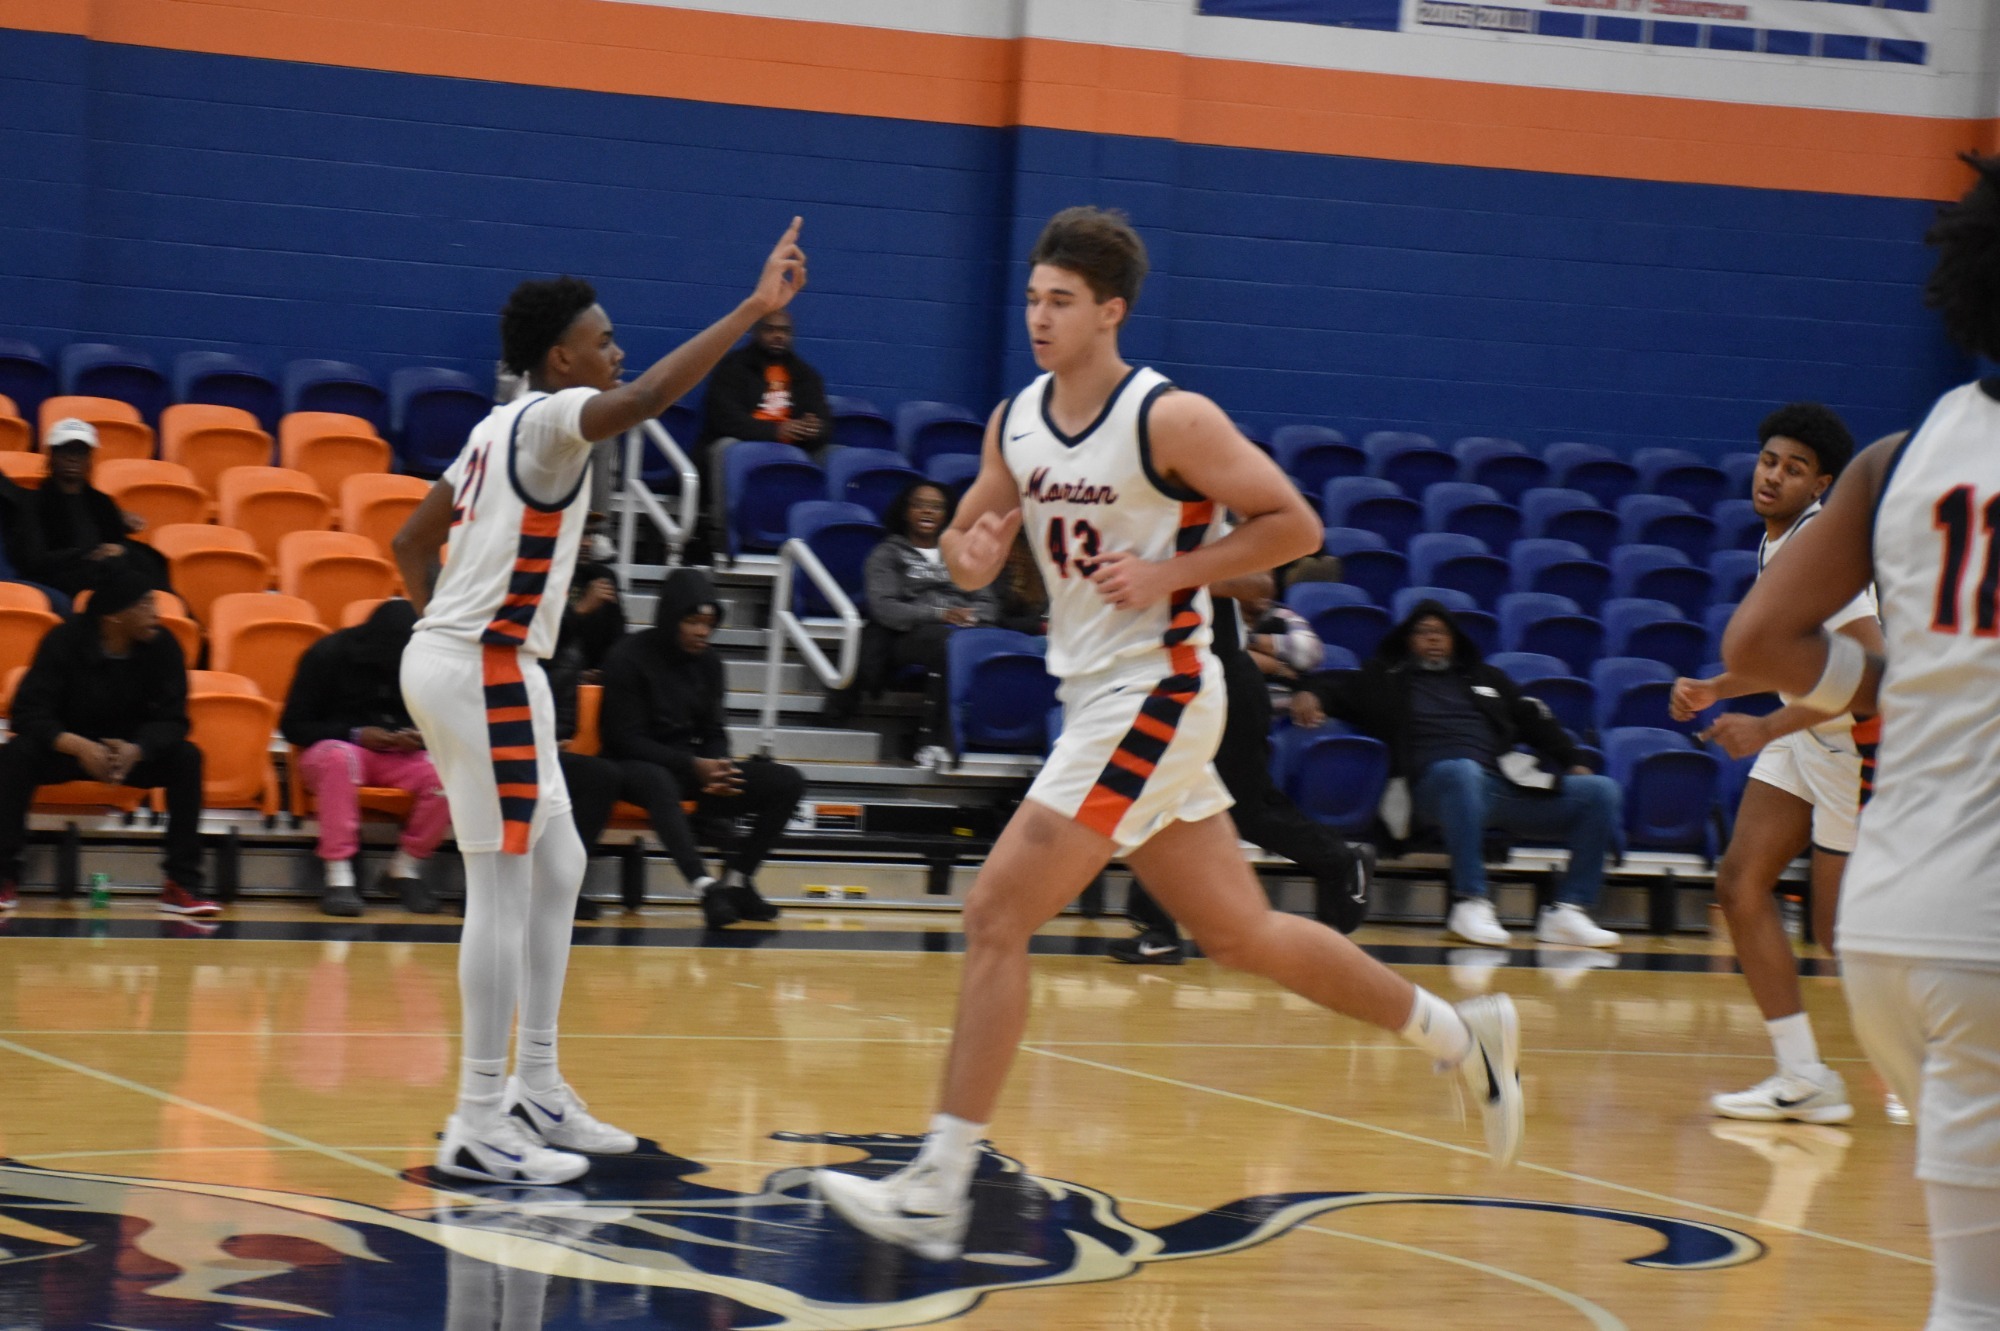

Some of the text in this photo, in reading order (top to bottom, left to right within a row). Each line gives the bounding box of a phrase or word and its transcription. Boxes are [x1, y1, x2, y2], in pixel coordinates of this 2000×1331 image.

[450, 441, 493, 527] 21
[1021, 467, 1119, 505] Morton
[1046, 515, 1102, 579] 43
